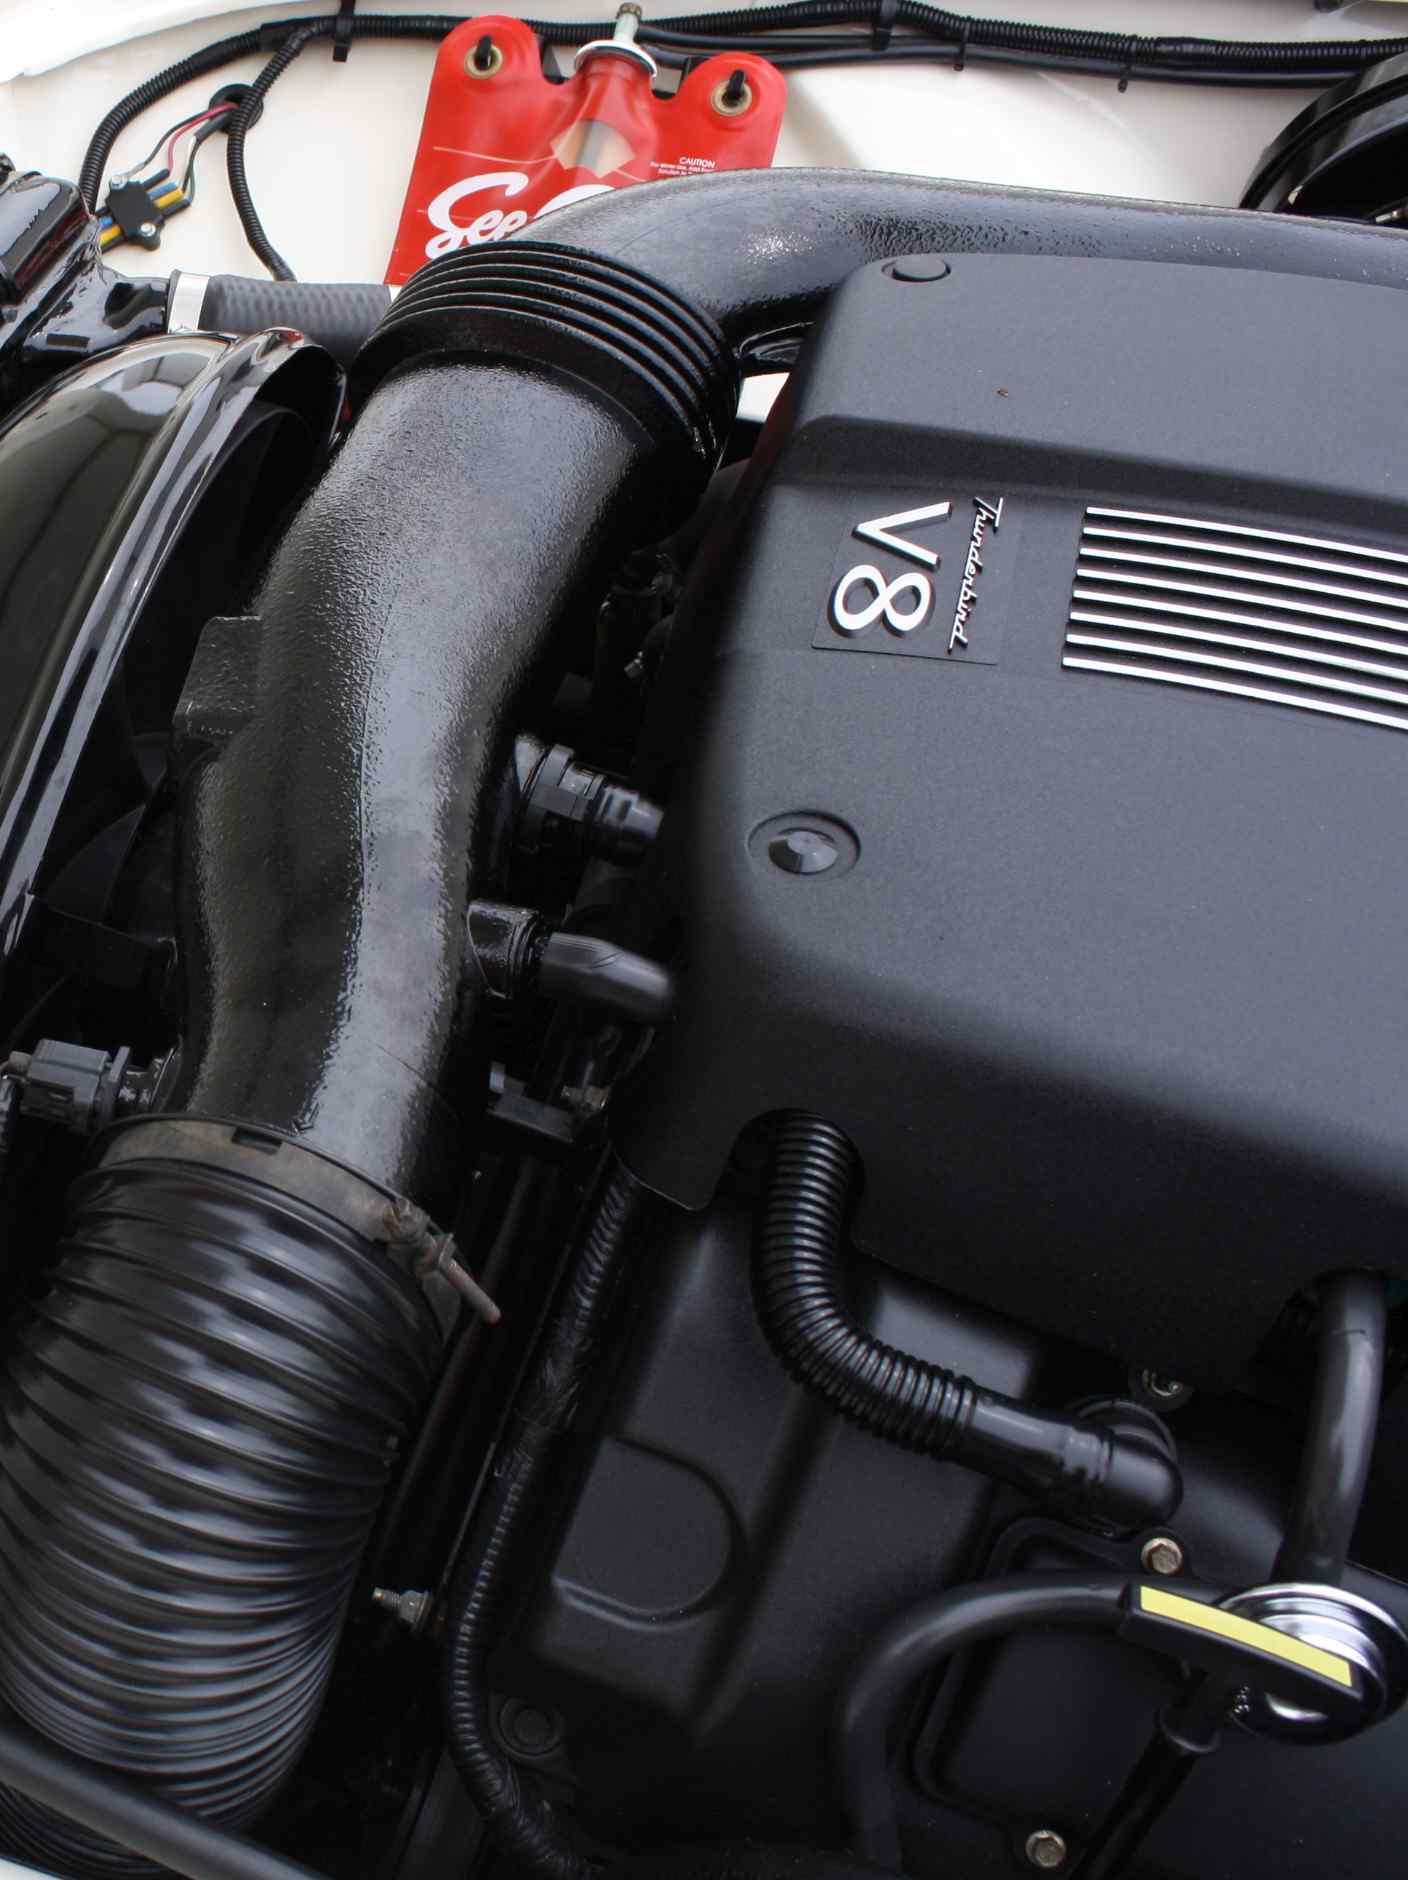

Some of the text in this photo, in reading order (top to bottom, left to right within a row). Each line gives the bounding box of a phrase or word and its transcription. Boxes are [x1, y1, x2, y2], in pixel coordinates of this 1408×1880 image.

[679, 156, 716, 169] CAUTION
[832, 501, 951, 632] V8
[947, 497, 1004, 652] Thunderbird
